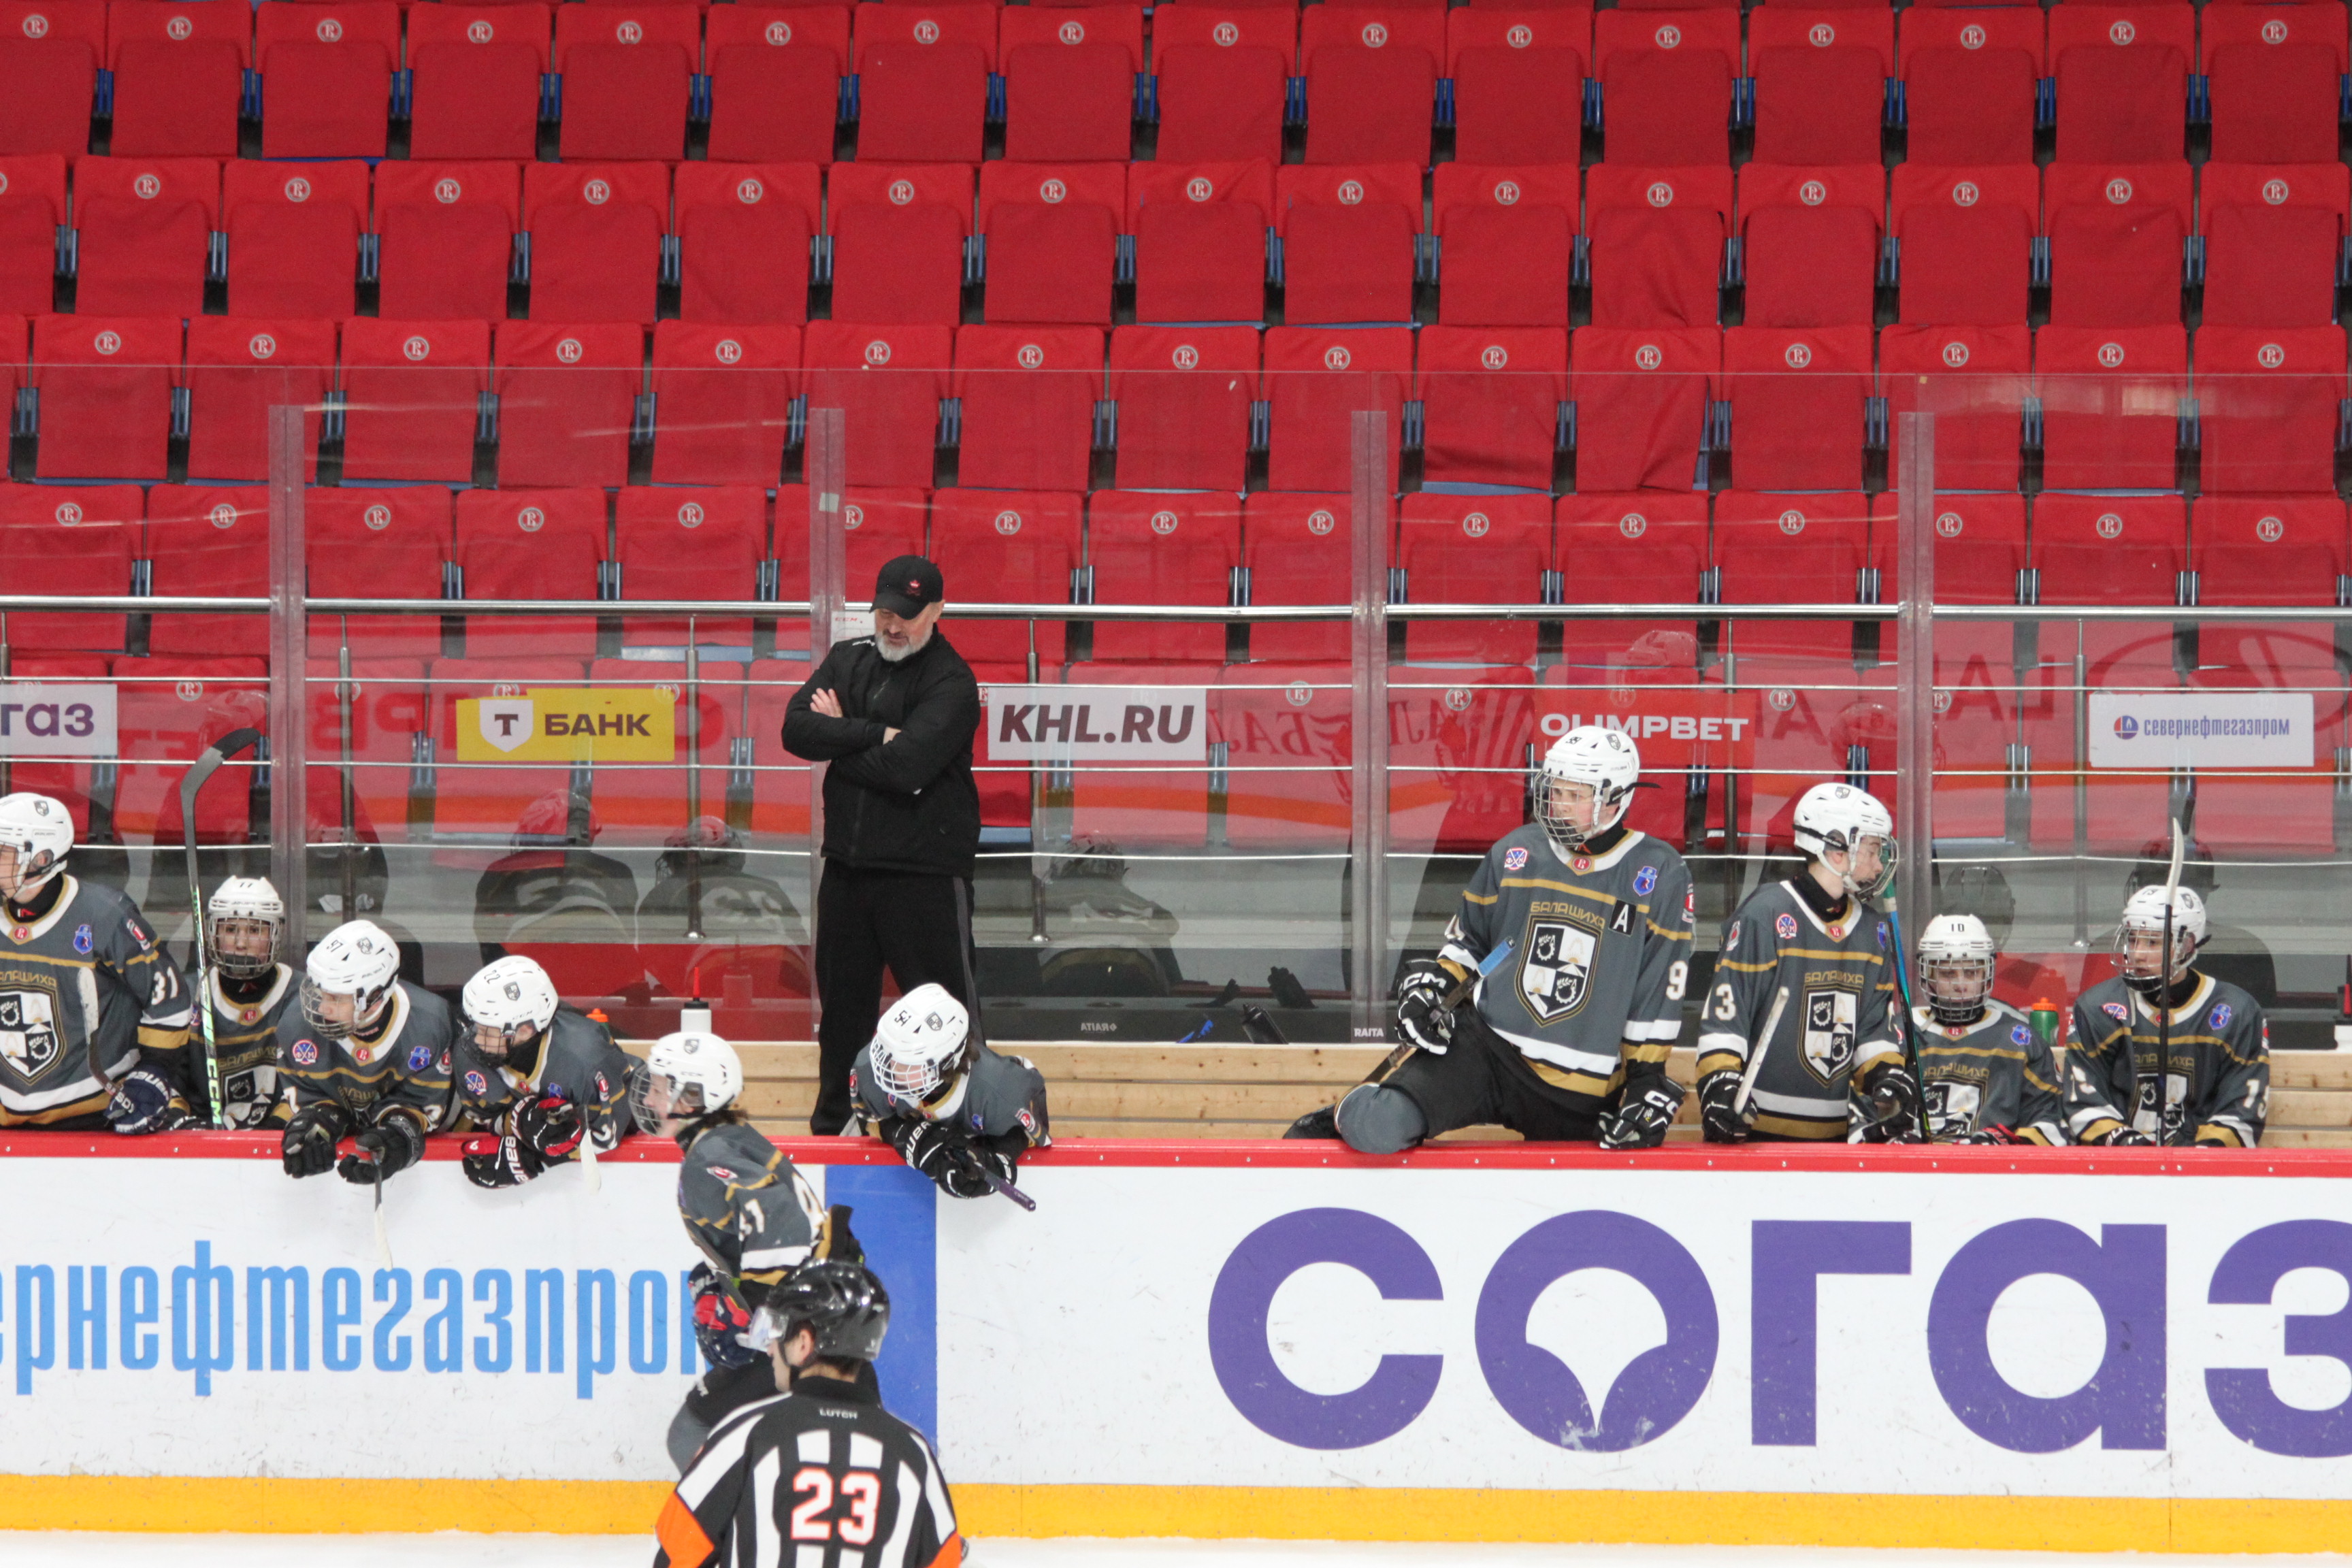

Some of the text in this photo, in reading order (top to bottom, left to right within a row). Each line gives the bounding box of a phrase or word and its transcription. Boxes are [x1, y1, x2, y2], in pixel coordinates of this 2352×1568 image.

[544, 713, 651, 737] БАНК
[998, 704, 1195, 743] KHL.RU
[1531, 902, 1605, 930] БАЛАШИХА
[1612, 904, 1629, 933] A
[151, 966, 179, 1006] 31
[1353, 1027, 1385, 1038] RAITA
[0, 1240, 715, 1399] рнефтегазпро
[819, 1407, 858, 1420] LUTCH
[790, 1466, 882, 1546] 23
